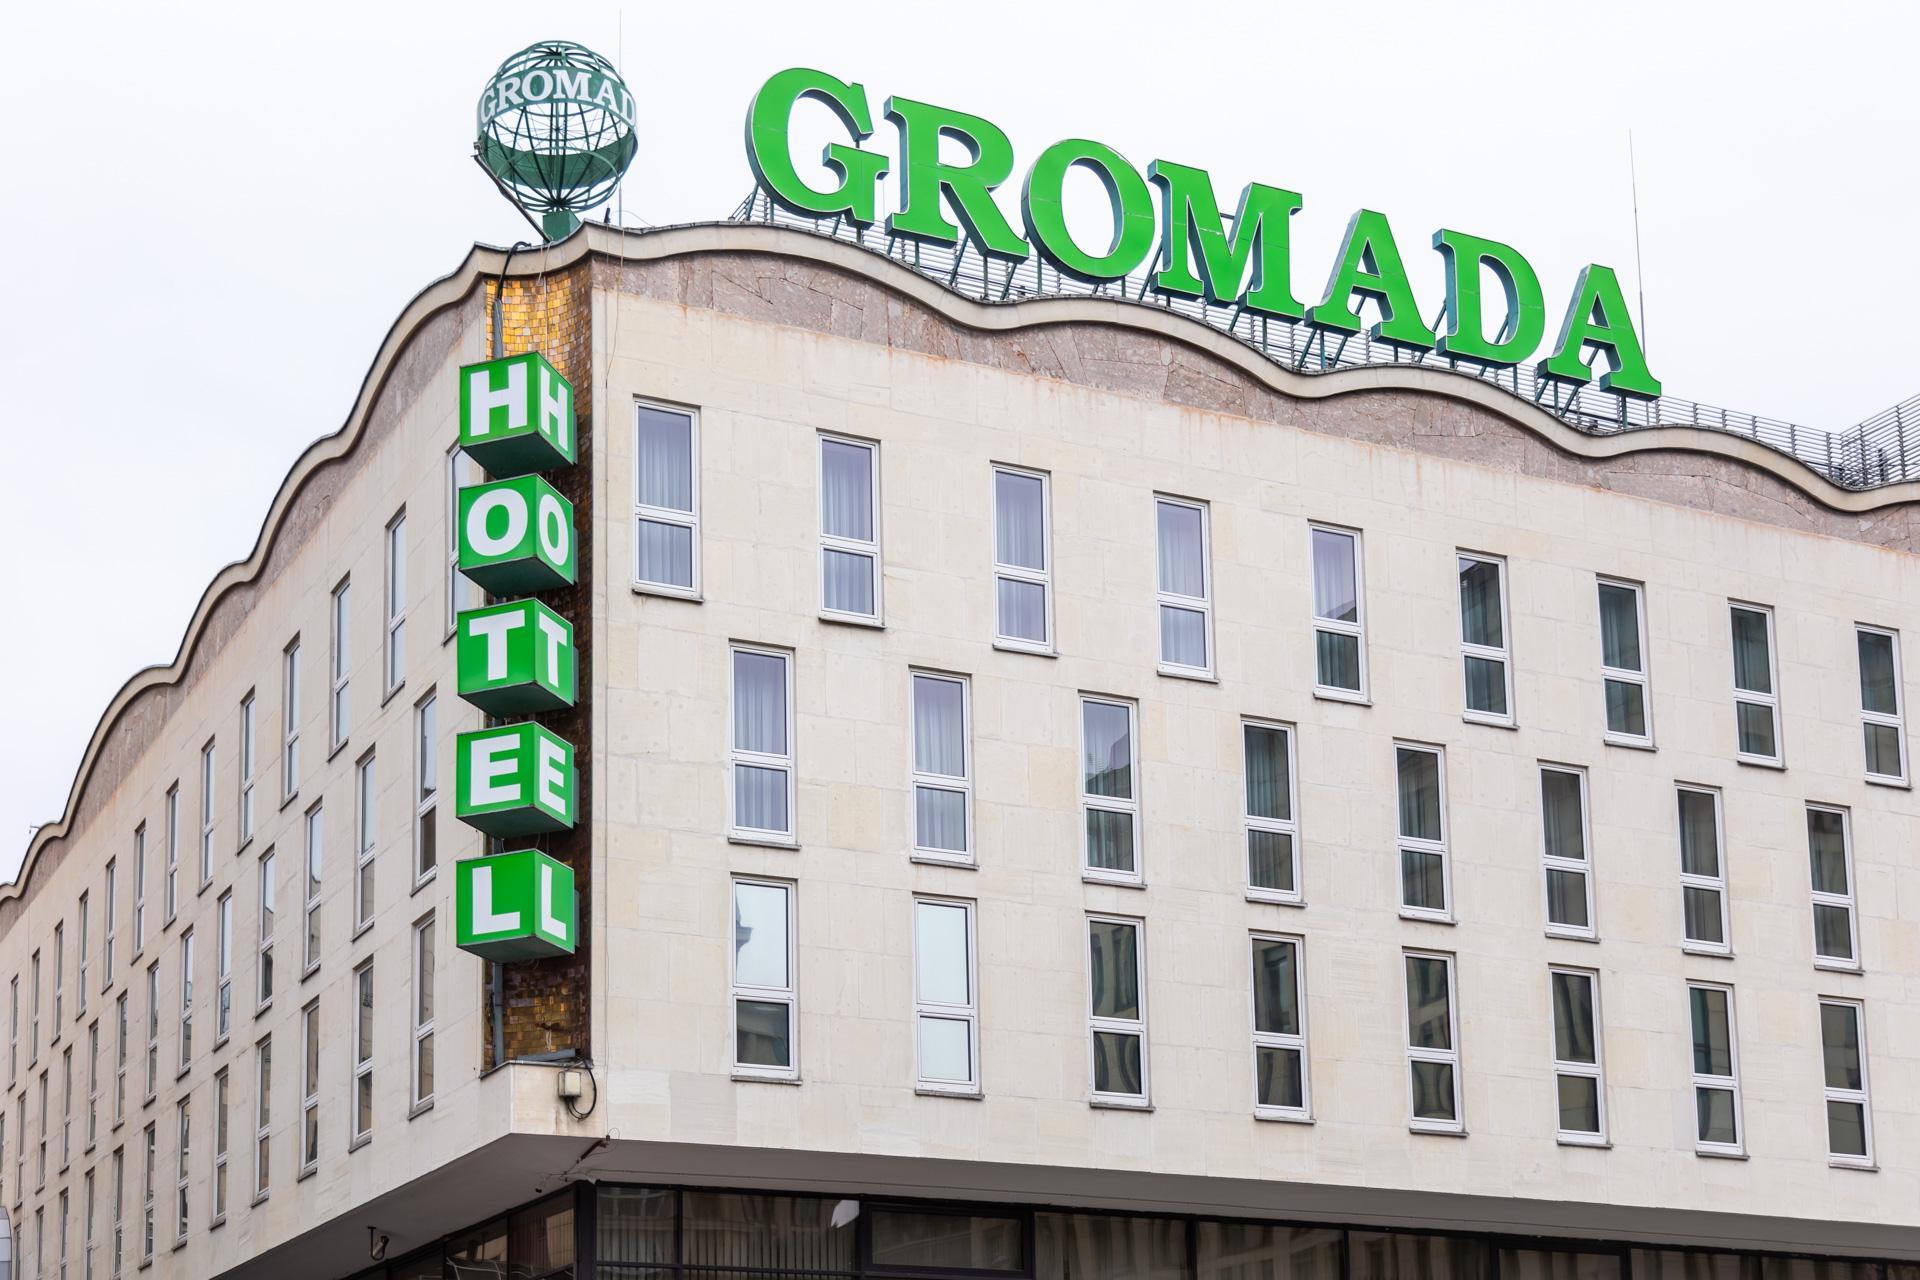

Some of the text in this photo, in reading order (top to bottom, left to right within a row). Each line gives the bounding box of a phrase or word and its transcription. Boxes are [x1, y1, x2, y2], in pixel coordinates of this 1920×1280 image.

[745, 68, 1661, 398] GROMADA
[466, 362, 528, 936] HOTEL
[538, 365, 570, 941] HOTEL
